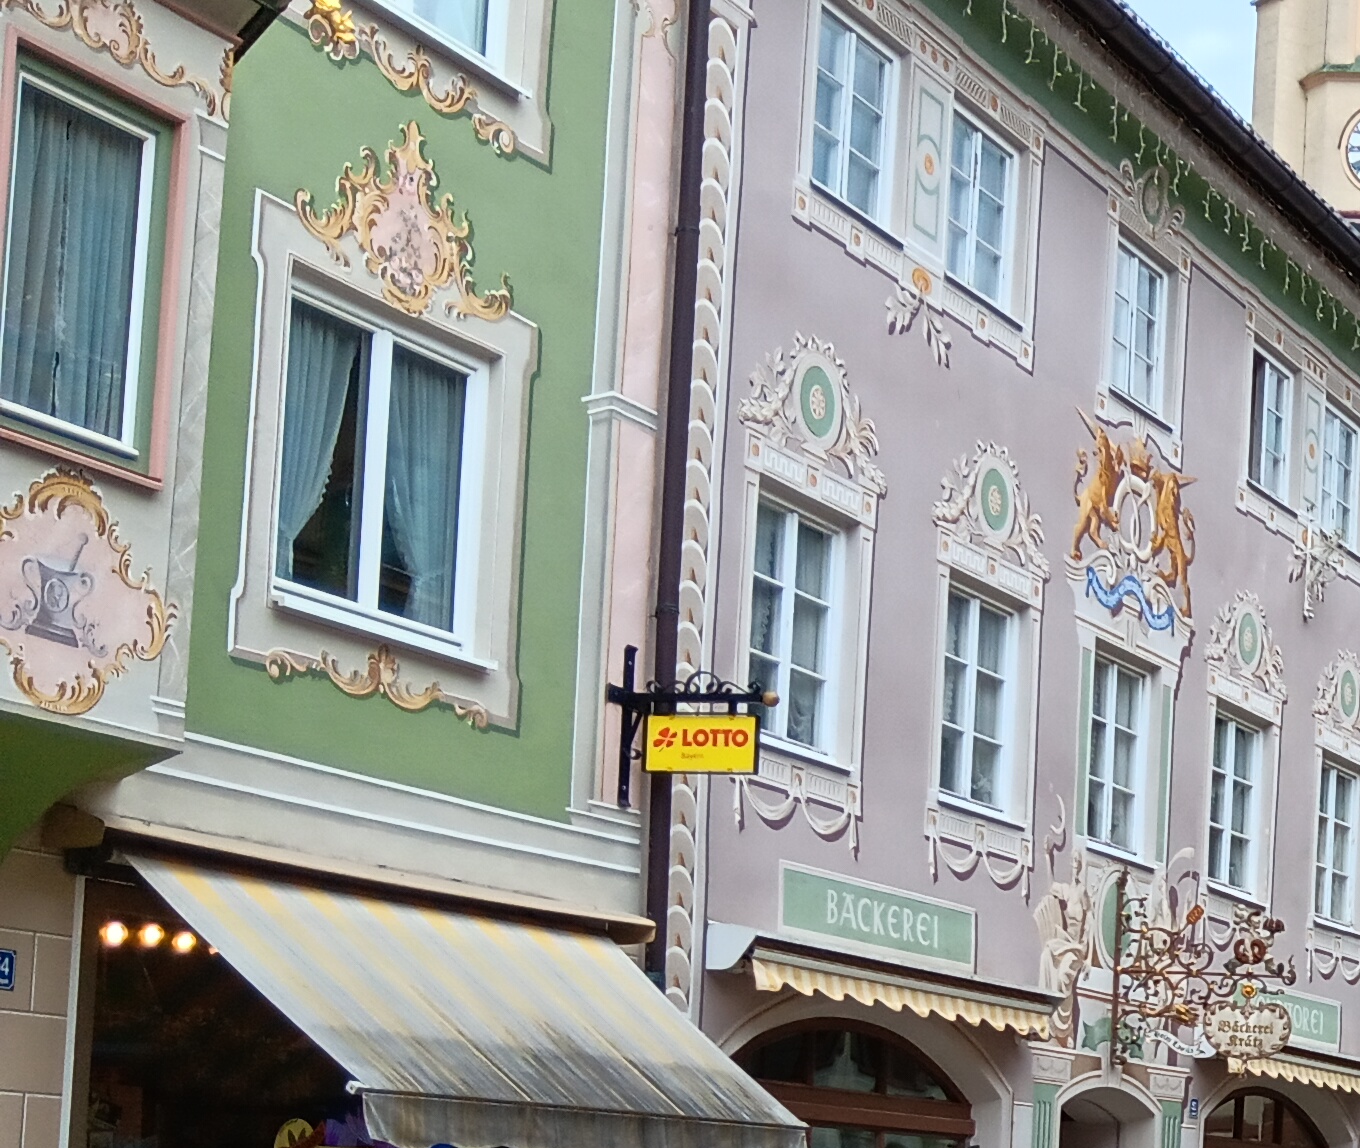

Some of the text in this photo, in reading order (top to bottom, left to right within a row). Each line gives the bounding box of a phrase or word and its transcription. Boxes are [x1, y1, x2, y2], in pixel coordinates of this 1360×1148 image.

[682, 728, 749, 748] LOTTO
[827, 889, 938, 949] BÄCKEREI
[0, 957, 9, 976] 4
[1217, 1020, 1275, 1036] Bäckerei
